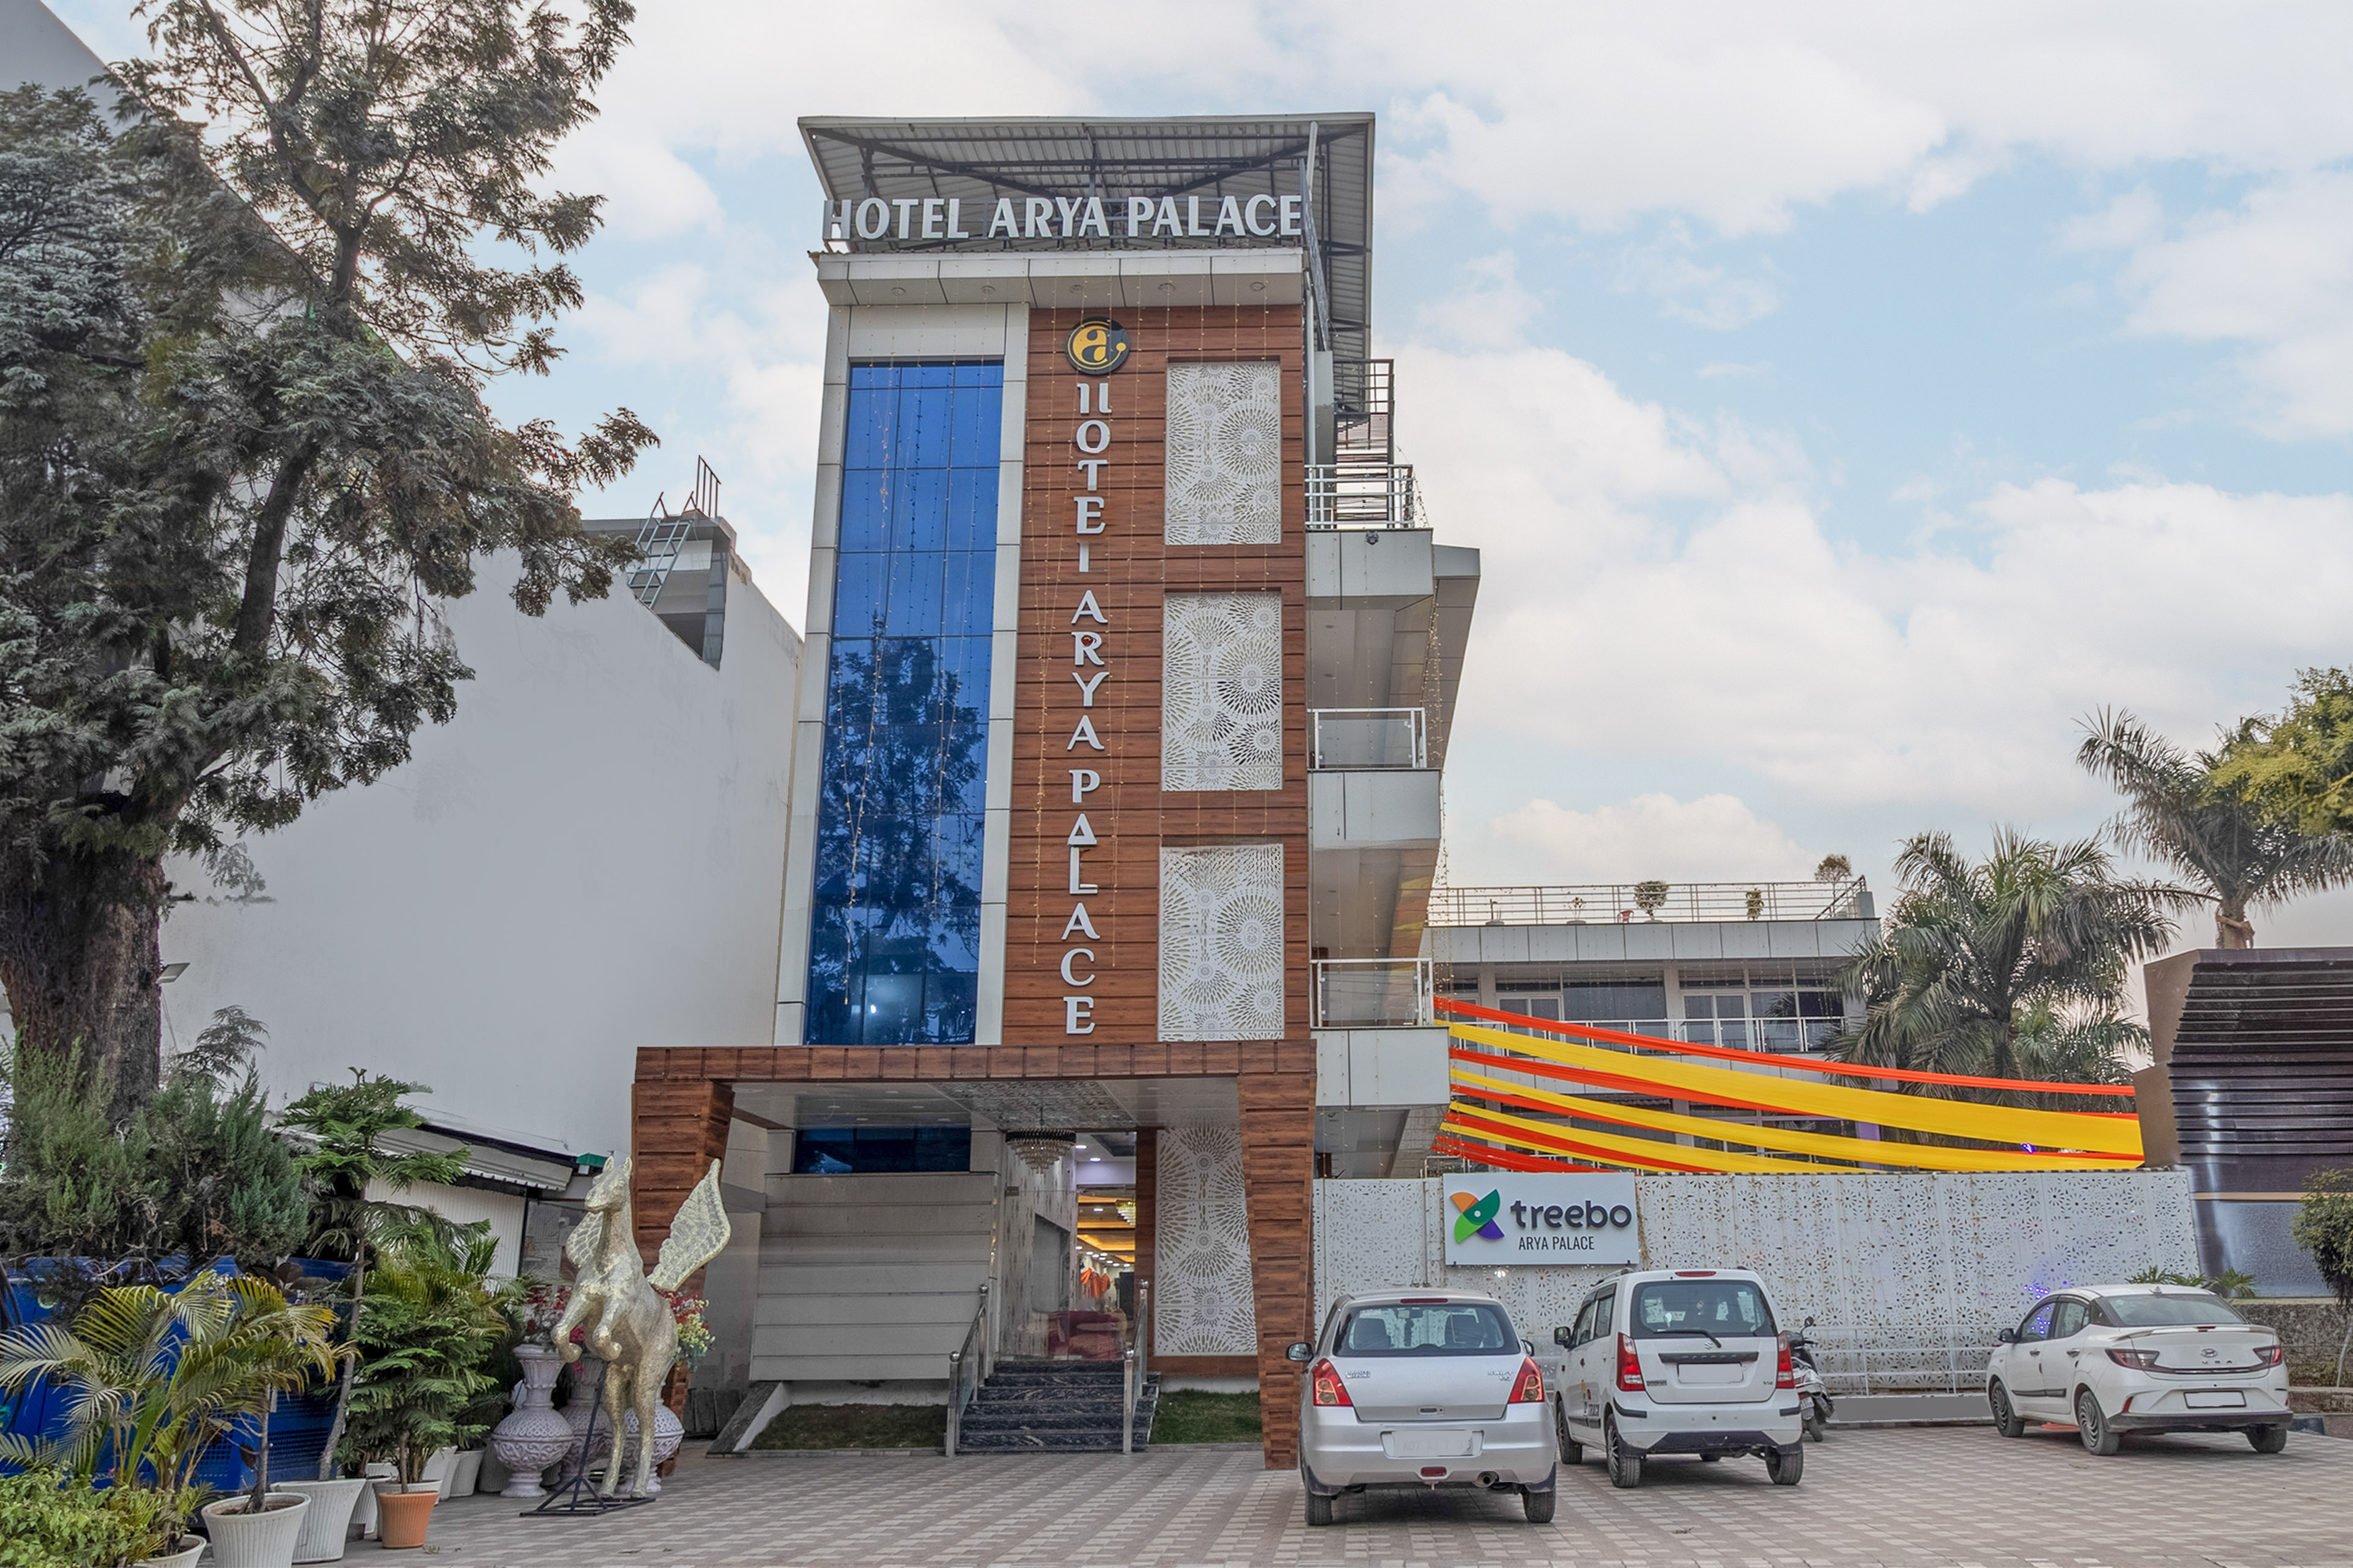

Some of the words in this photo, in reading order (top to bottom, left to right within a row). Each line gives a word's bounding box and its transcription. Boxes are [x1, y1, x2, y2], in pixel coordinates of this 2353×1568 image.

[822, 197, 969, 240] HOTEL
[988, 197, 1110, 238] ARYA
[1128, 194, 1302, 237] PALACE
[1067, 590, 1110, 751] ARYA
[1060, 769, 1101, 1034] PALACE
[1510, 1200, 1632, 1229] treebo
[1518, 1236, 1549, 1251] ARYA
[1553, 1235, 1595, 1251] PALACE
